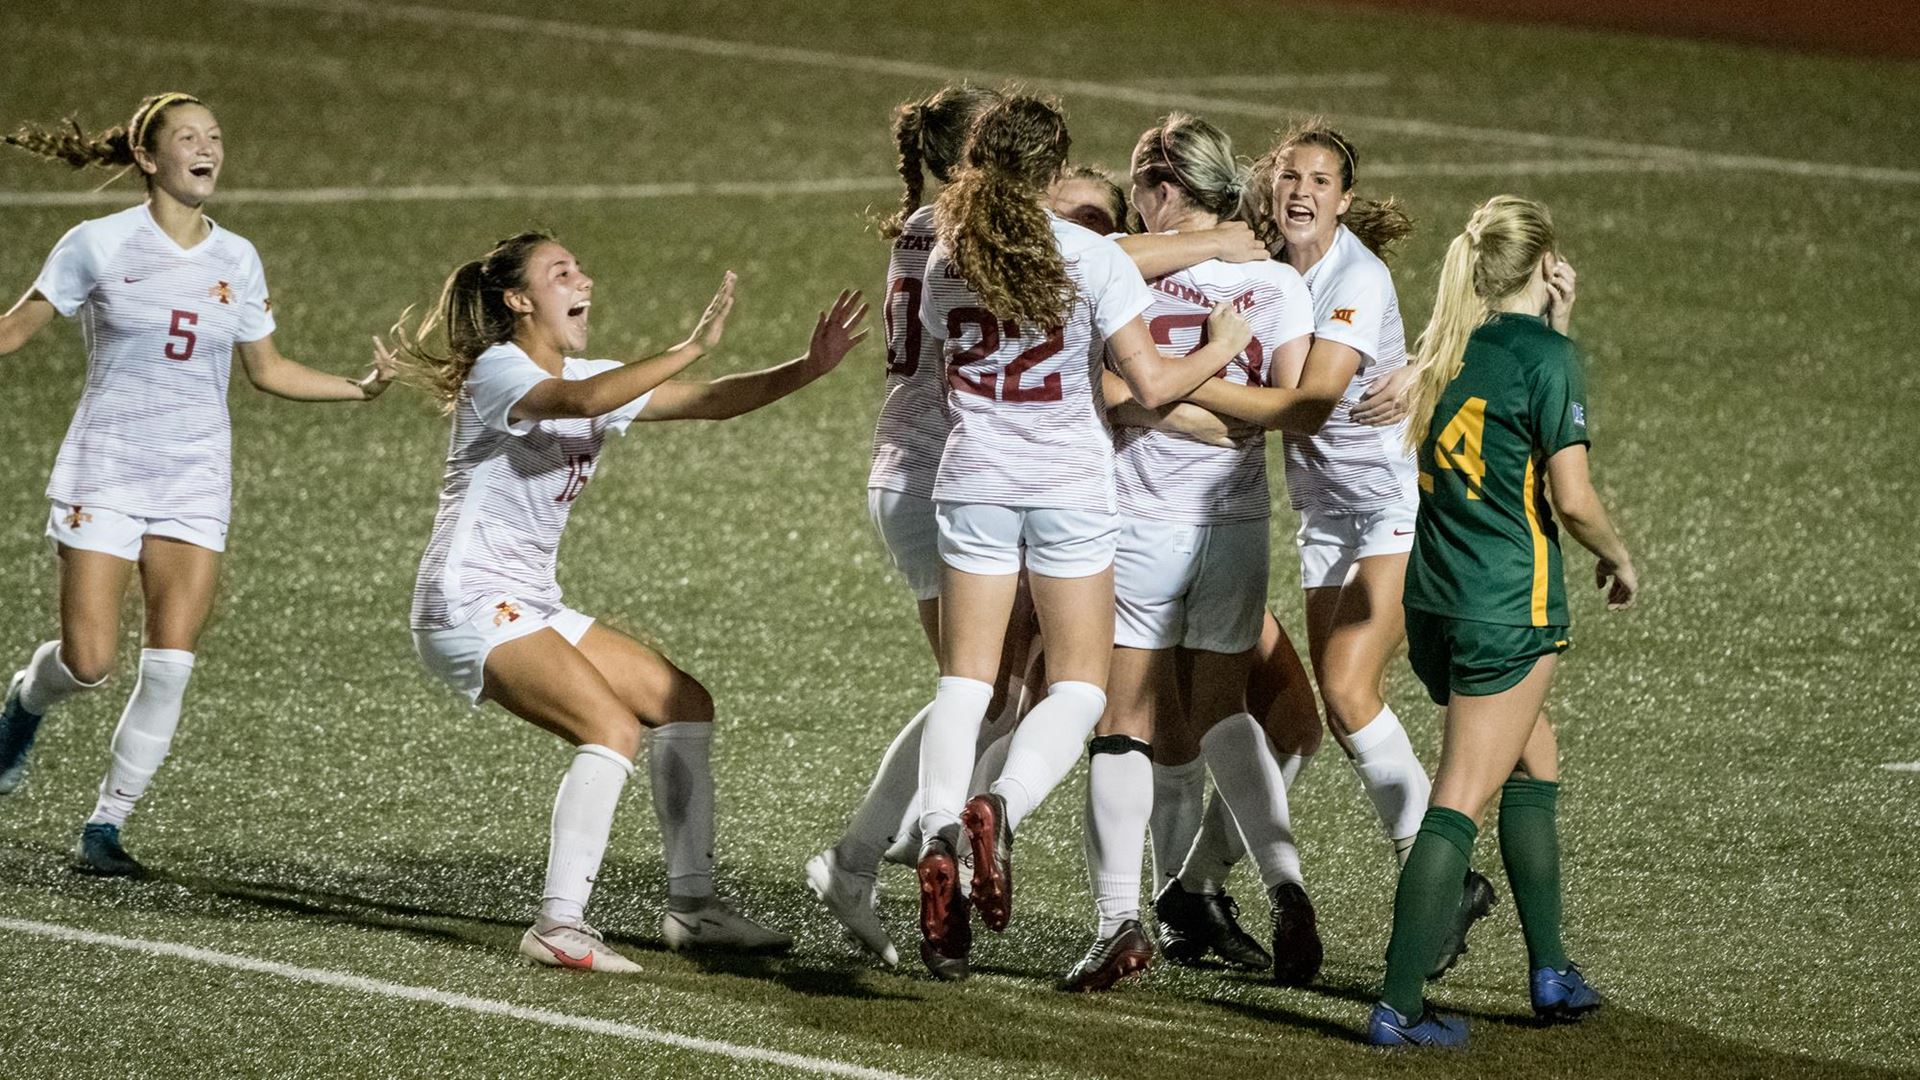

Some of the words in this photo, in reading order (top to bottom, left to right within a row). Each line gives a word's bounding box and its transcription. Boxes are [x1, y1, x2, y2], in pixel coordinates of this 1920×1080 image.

[164, 309, 198, 361] 5
[946, 307, 1065, 402] 22
[554, 454, 593, 502] 16
